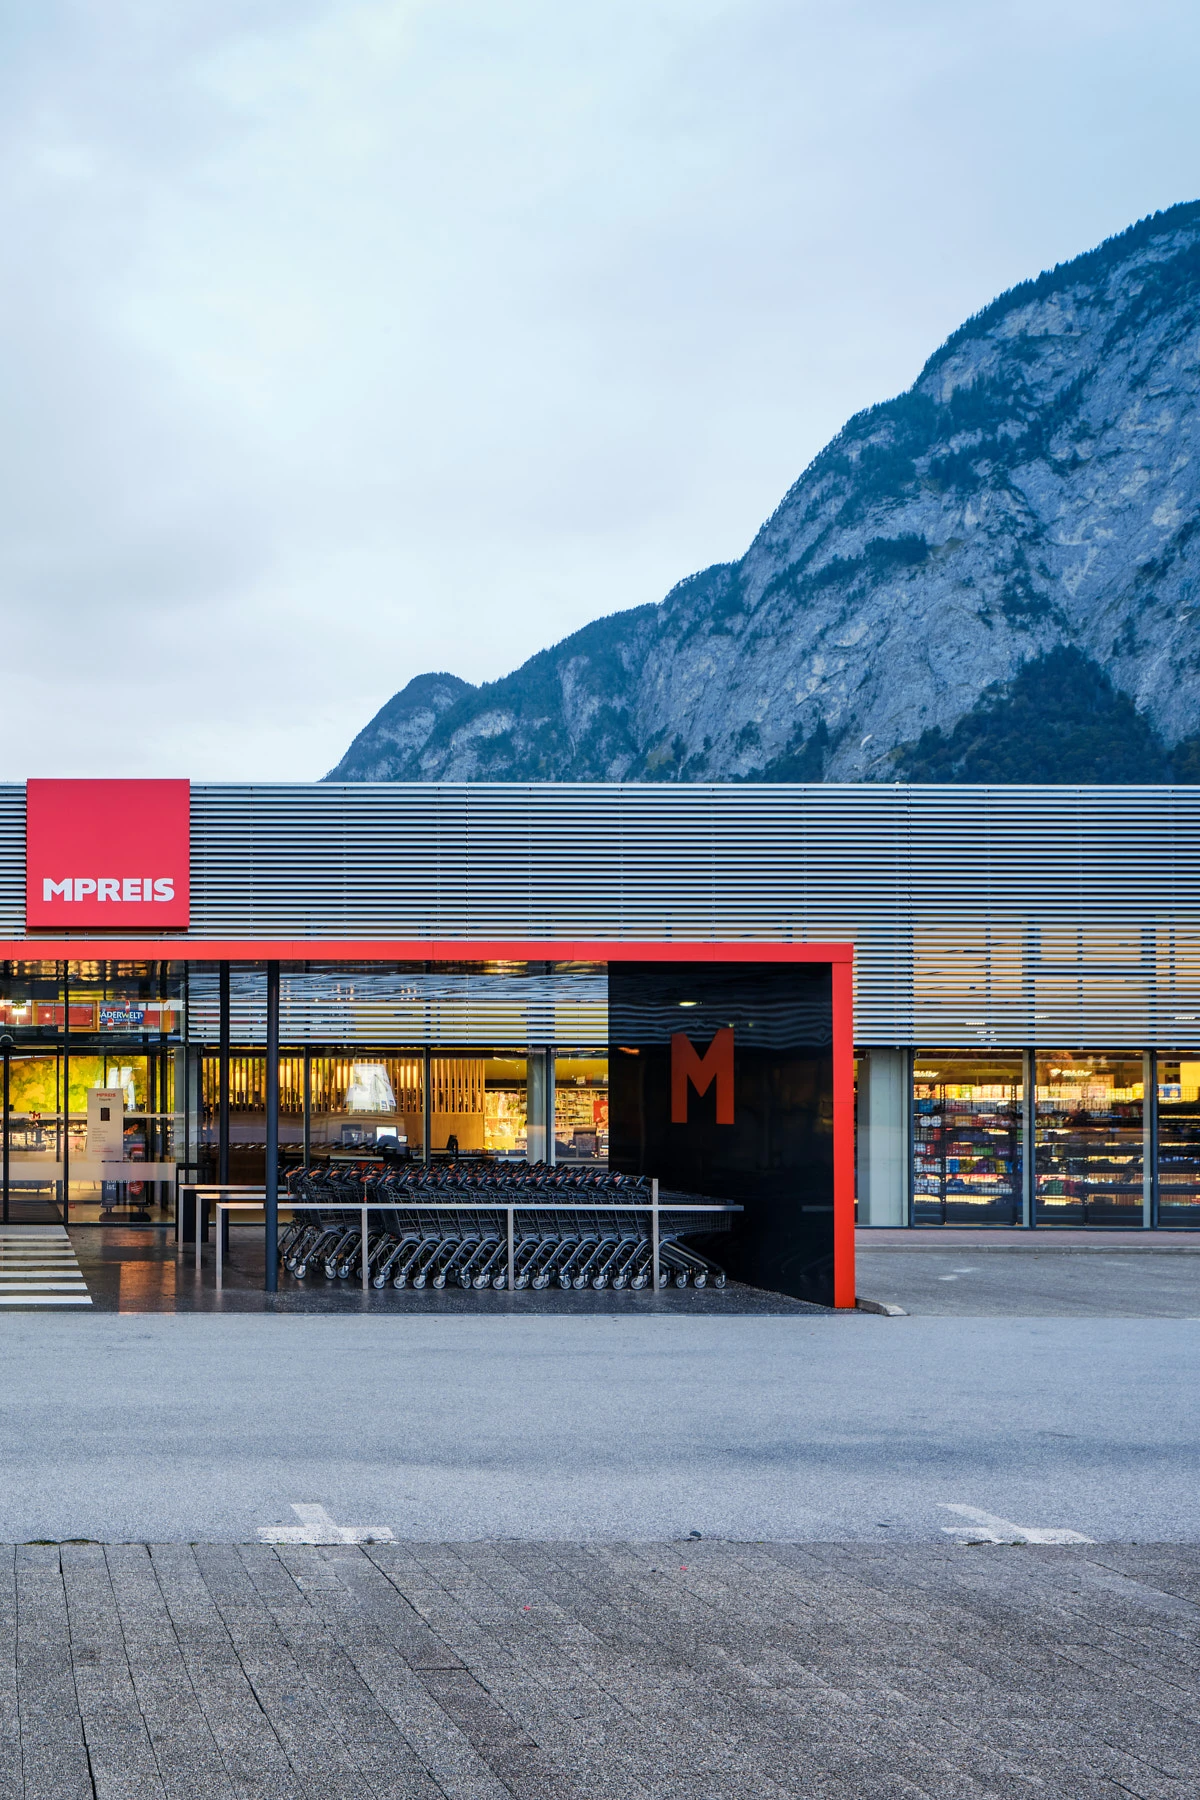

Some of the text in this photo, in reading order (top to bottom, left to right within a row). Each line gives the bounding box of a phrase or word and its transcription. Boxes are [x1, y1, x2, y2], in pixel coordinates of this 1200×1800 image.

[42, 877, 175, 902] MPREIS
[99, 1009, 142, 1019] ÄDERWELT
[671, 1028, 734, 1125] M
